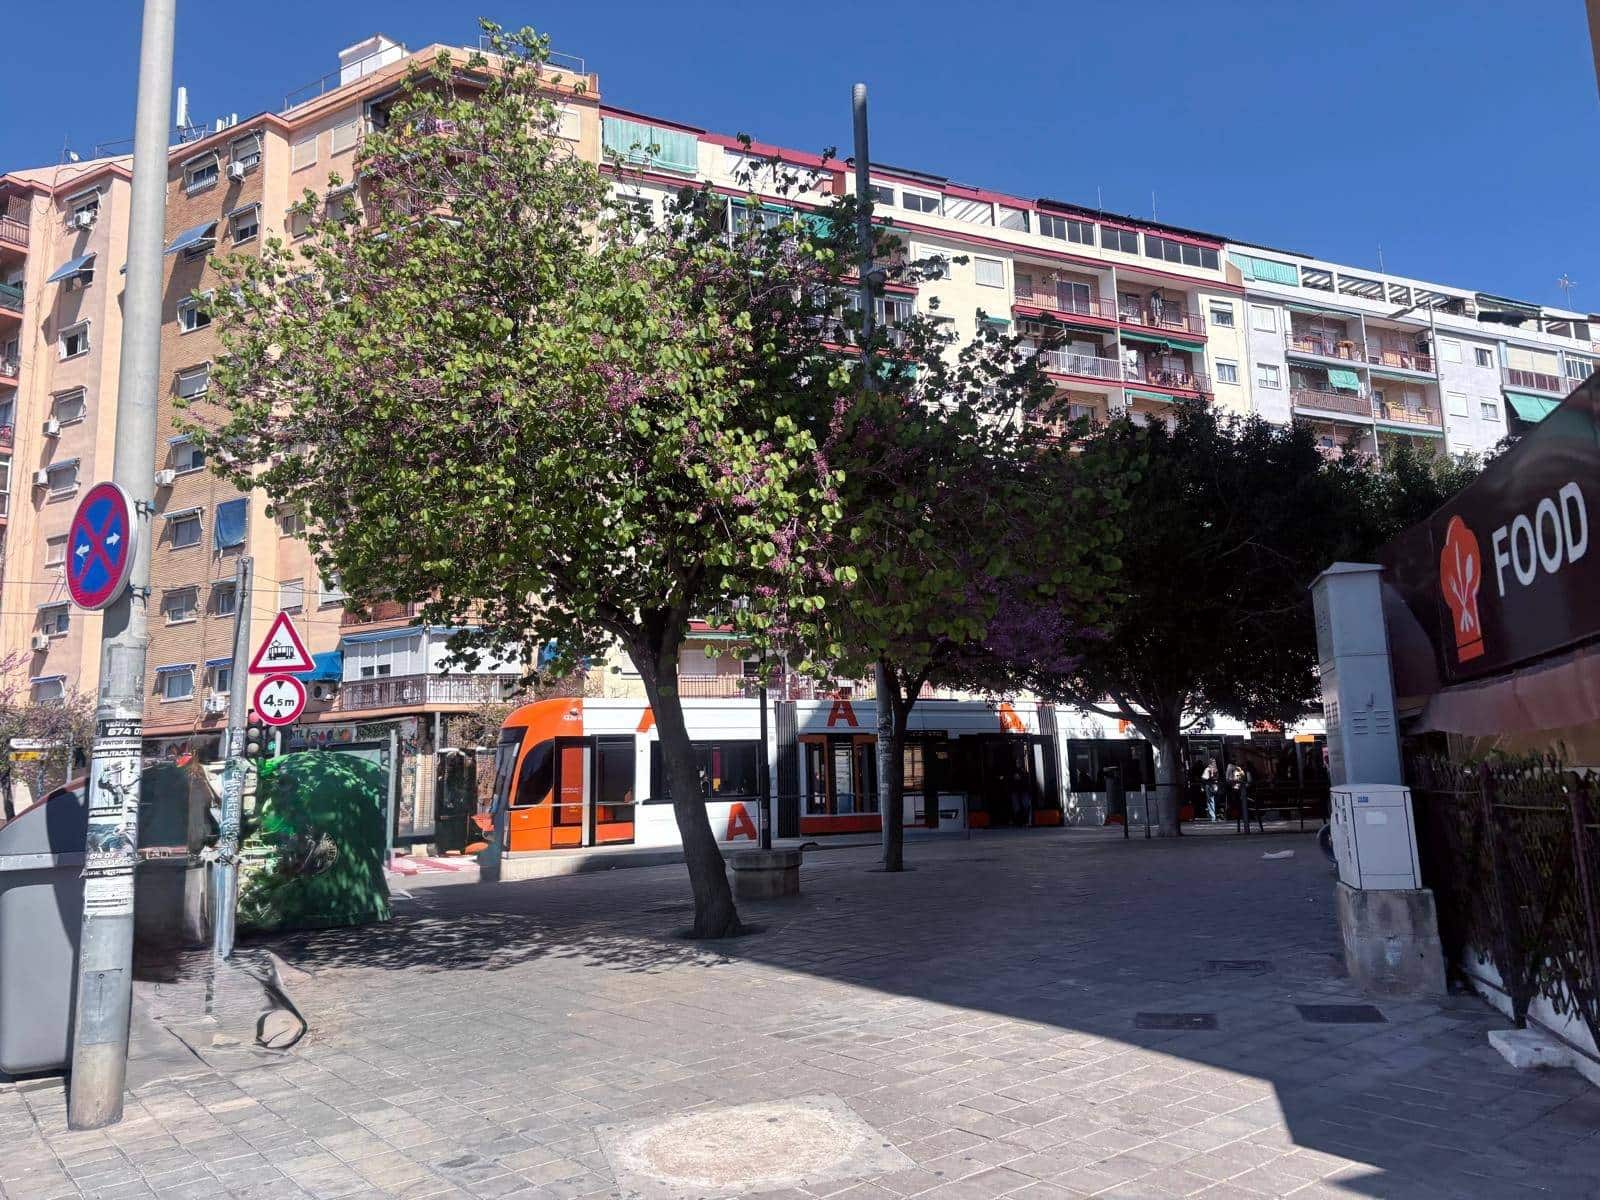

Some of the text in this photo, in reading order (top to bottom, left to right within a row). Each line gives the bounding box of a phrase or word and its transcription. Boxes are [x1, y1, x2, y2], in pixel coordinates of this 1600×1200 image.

[1492, 482, 1588, 597] FOOD
[107, 727, 132, 736] 674
[726, 802, 757, 841] A
